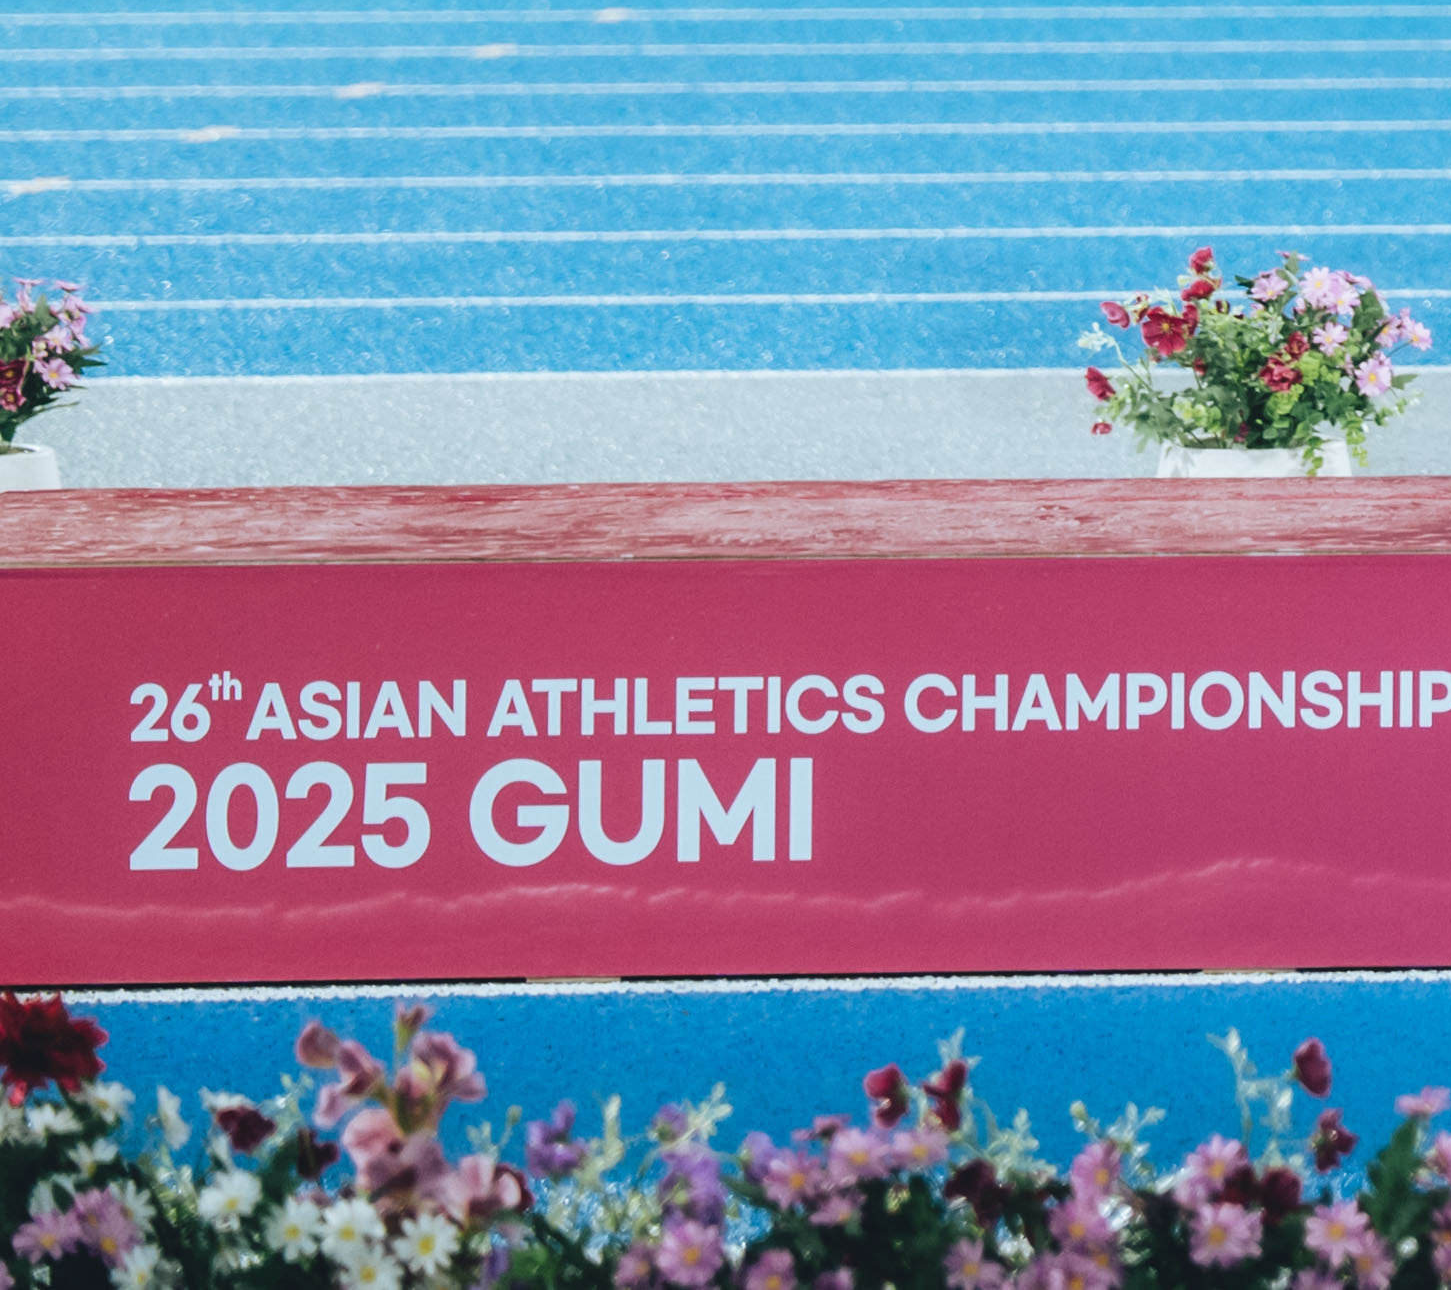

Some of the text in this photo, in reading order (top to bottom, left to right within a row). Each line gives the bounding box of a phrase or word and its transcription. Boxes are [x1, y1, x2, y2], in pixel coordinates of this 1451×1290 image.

[130, 671, 244, 743] 26th
[247, 678, 467, 740] ASIAN
[487, 674, 884, 737] ATHLETICS
[129, 757, 813, 871] 2025 GUMI
